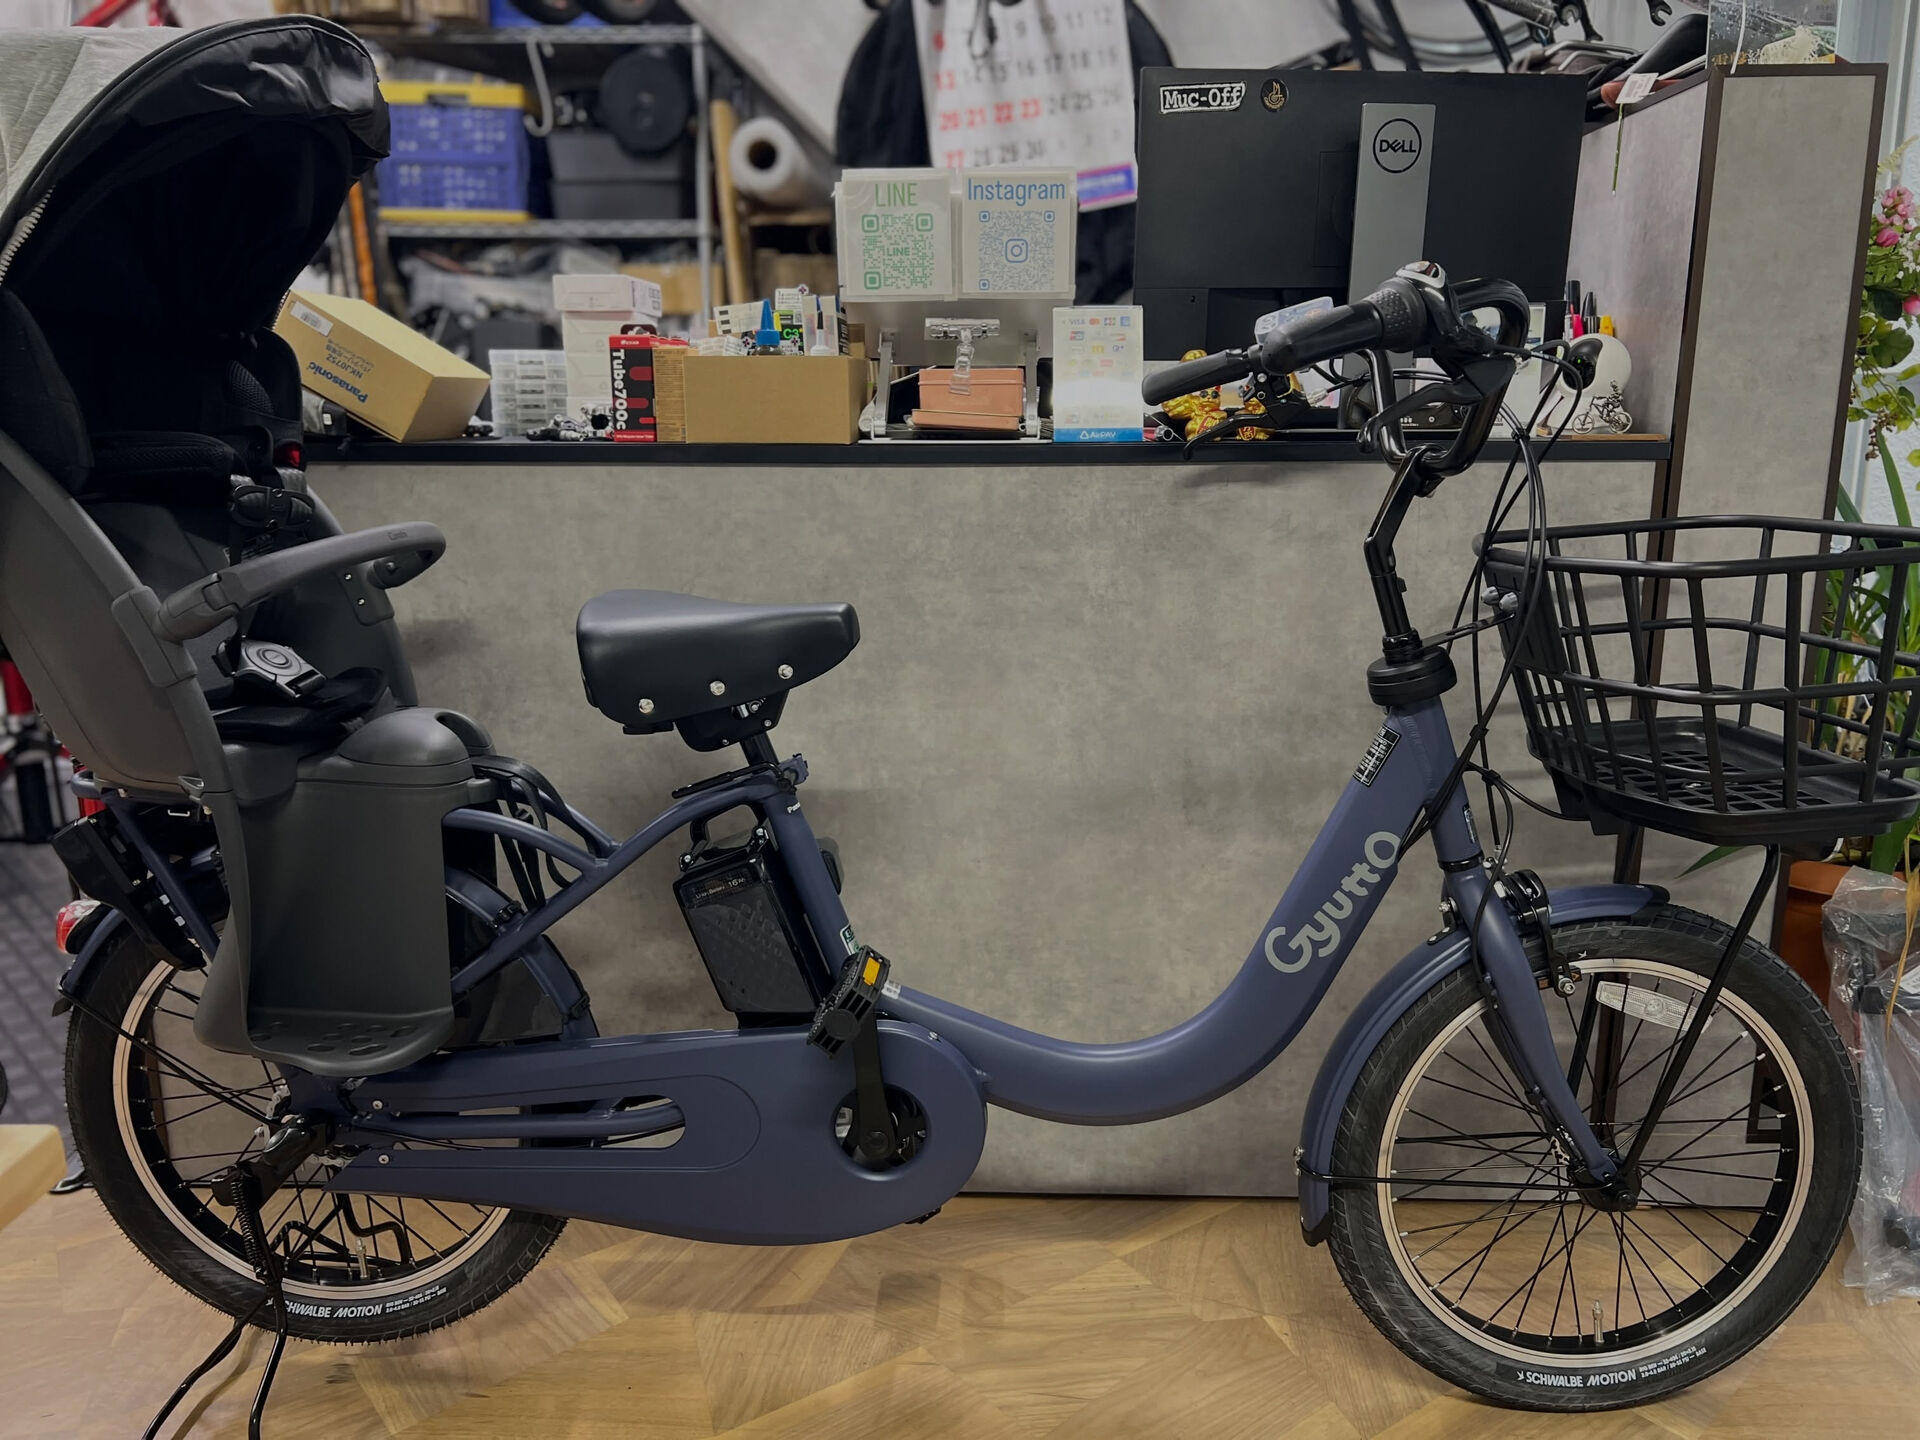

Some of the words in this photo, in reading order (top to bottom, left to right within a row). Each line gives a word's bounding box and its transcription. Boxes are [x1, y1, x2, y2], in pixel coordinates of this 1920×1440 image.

[1164, 86, 1243, 109] Muc-Off
[939, 111, 960, 131] 20
[966, 107, 986, 128] 21
[993, 101, 1014, 124] 22
[1020, 98, 1041, 119] 23
[1379, 139, 1416, 153] DELL
[874, 182, 919, 208] LINE
[967, 178, 1066, 207] Instagram
[886, 247, 911, 257] LINE
[306, 361, 369, 403] Panasonic
[610, 349, 629, 431] Tube700c
[284, 1300, 331, 1318] CHWALBE
[333, 1303, 383, 1318] MOTION
[1526, 1371, 1584, 1388] SCHWALBE
[1586, 1368, 1637, 1387] MOTION
